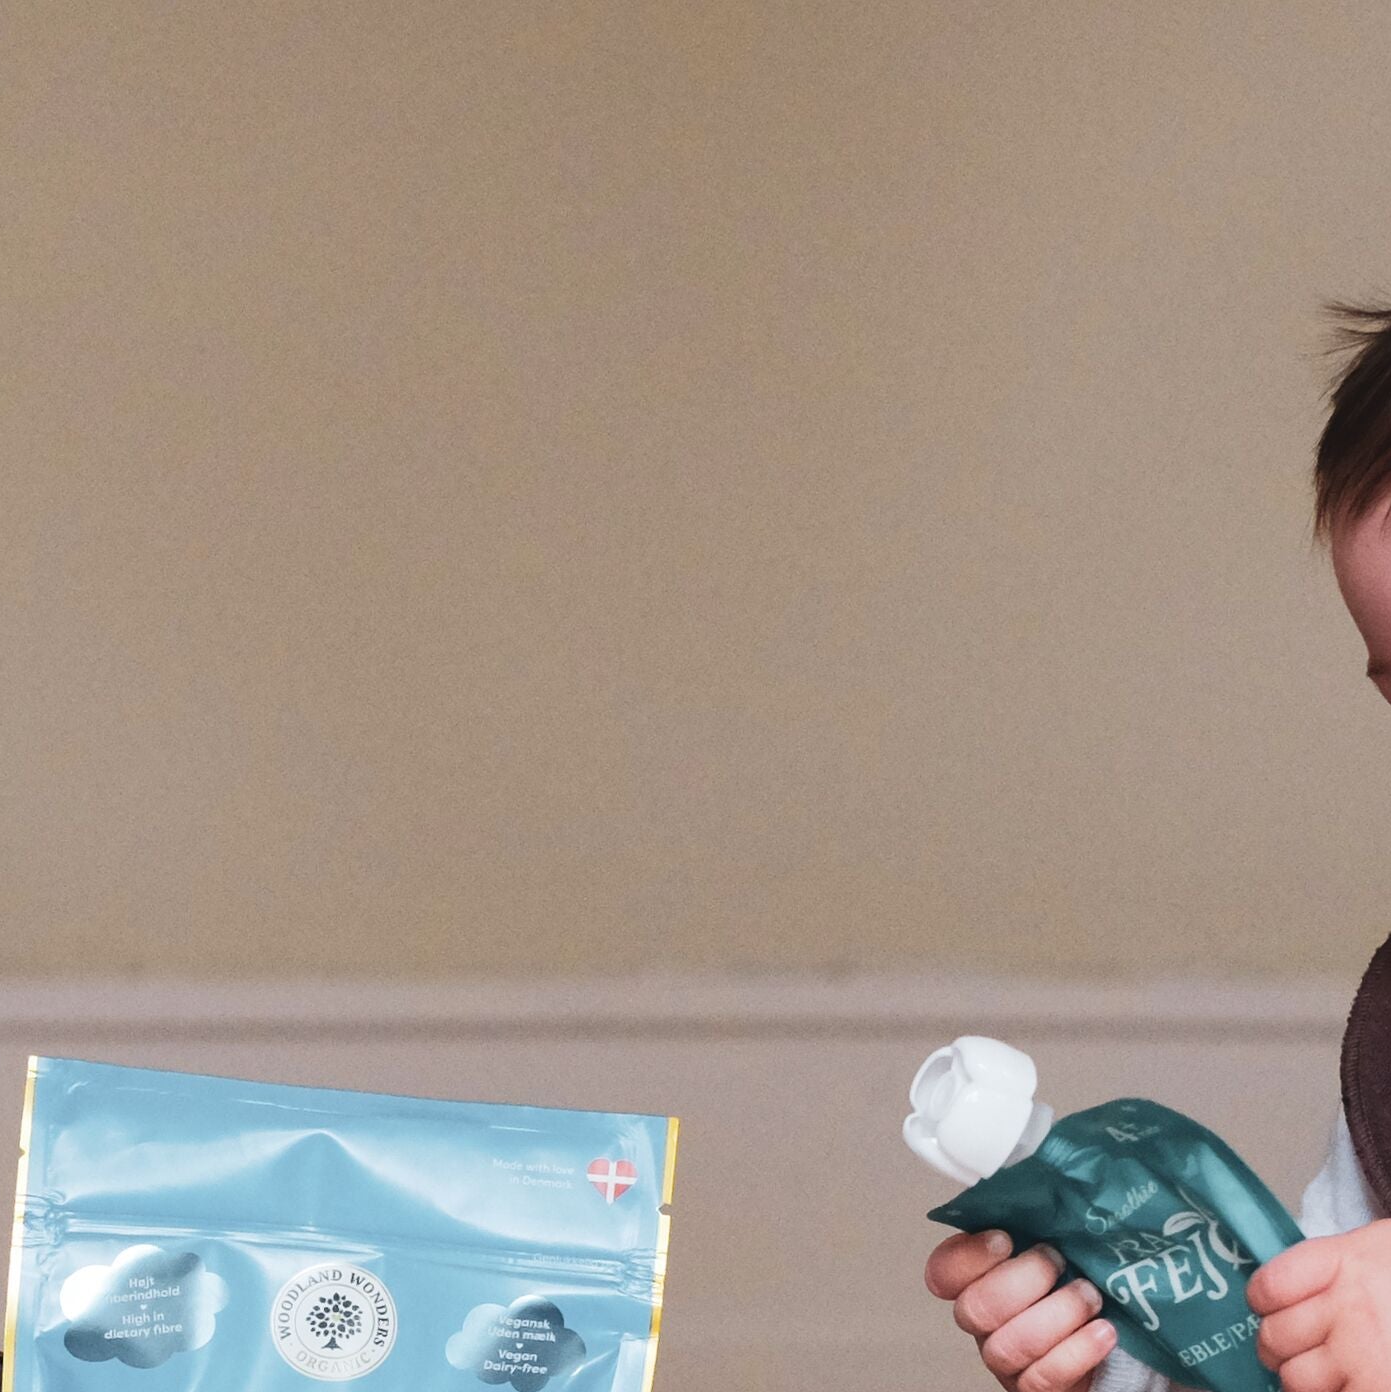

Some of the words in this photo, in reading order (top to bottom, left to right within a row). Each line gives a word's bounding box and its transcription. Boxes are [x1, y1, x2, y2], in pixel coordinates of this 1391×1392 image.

[493, 1159, 523, 1171] Made
[526, 1162, 550, 1173] with
[552, 1164, 575, 1175] love
[522, 1176, 574, 1190] Denmark
[278, 1269, 343, 1341] WOODLAND
[350, 1272, 390, 1347] WONDERS
[122, 1313, 150, 1326] High
[153, 1311, 165, 1322] in
[497, 1314, 551, 1331] Vegansk
[104, 1327, 151, 1340] dietary
[153, 1323, 183, 1335] fibre
[487, 1325, 520, 1340] Uden
[522, 1330, 557, 1343] mælk
[296, 1350, 371, 1374] ORGANIC
[498, 1349, 538, 1363] Vegan
[483, 1359, 548, 1375] Dairy-free
